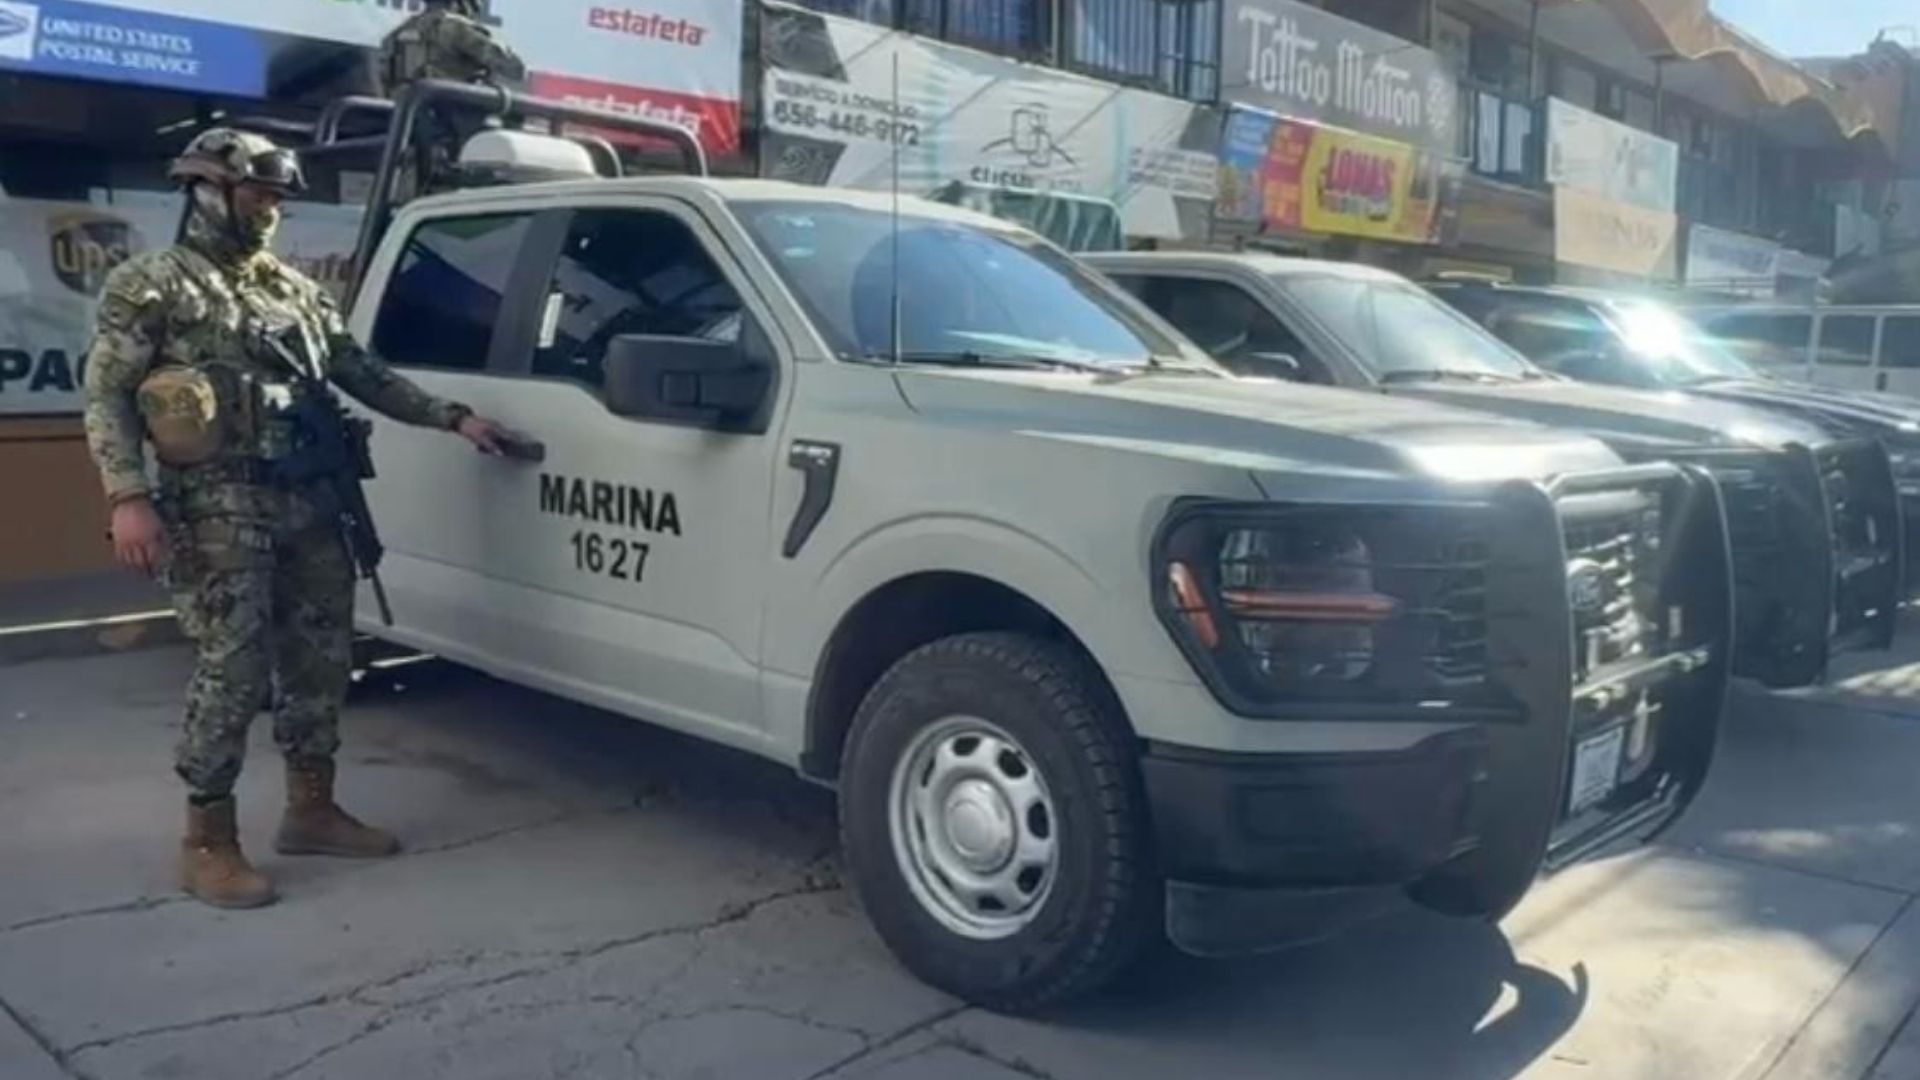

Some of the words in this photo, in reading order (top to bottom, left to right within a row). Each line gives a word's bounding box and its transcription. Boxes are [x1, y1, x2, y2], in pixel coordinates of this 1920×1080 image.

[43, 18, 122, 42] UNITED
[125, 29, 192, 52] STATES
[589, 7, 704, 46] estafeta
[41, 40, 117, 64] POSTAL
[120, 51, 199, 74] SERVICE
[1238, 6, 1329, 105] Tattoo
[1335, 39, 1421, 127] Motion
[0, 347, 87, 392] PA
[539, 473, 682, 537] MARINA
[571, 530, 650, 582] 1627
